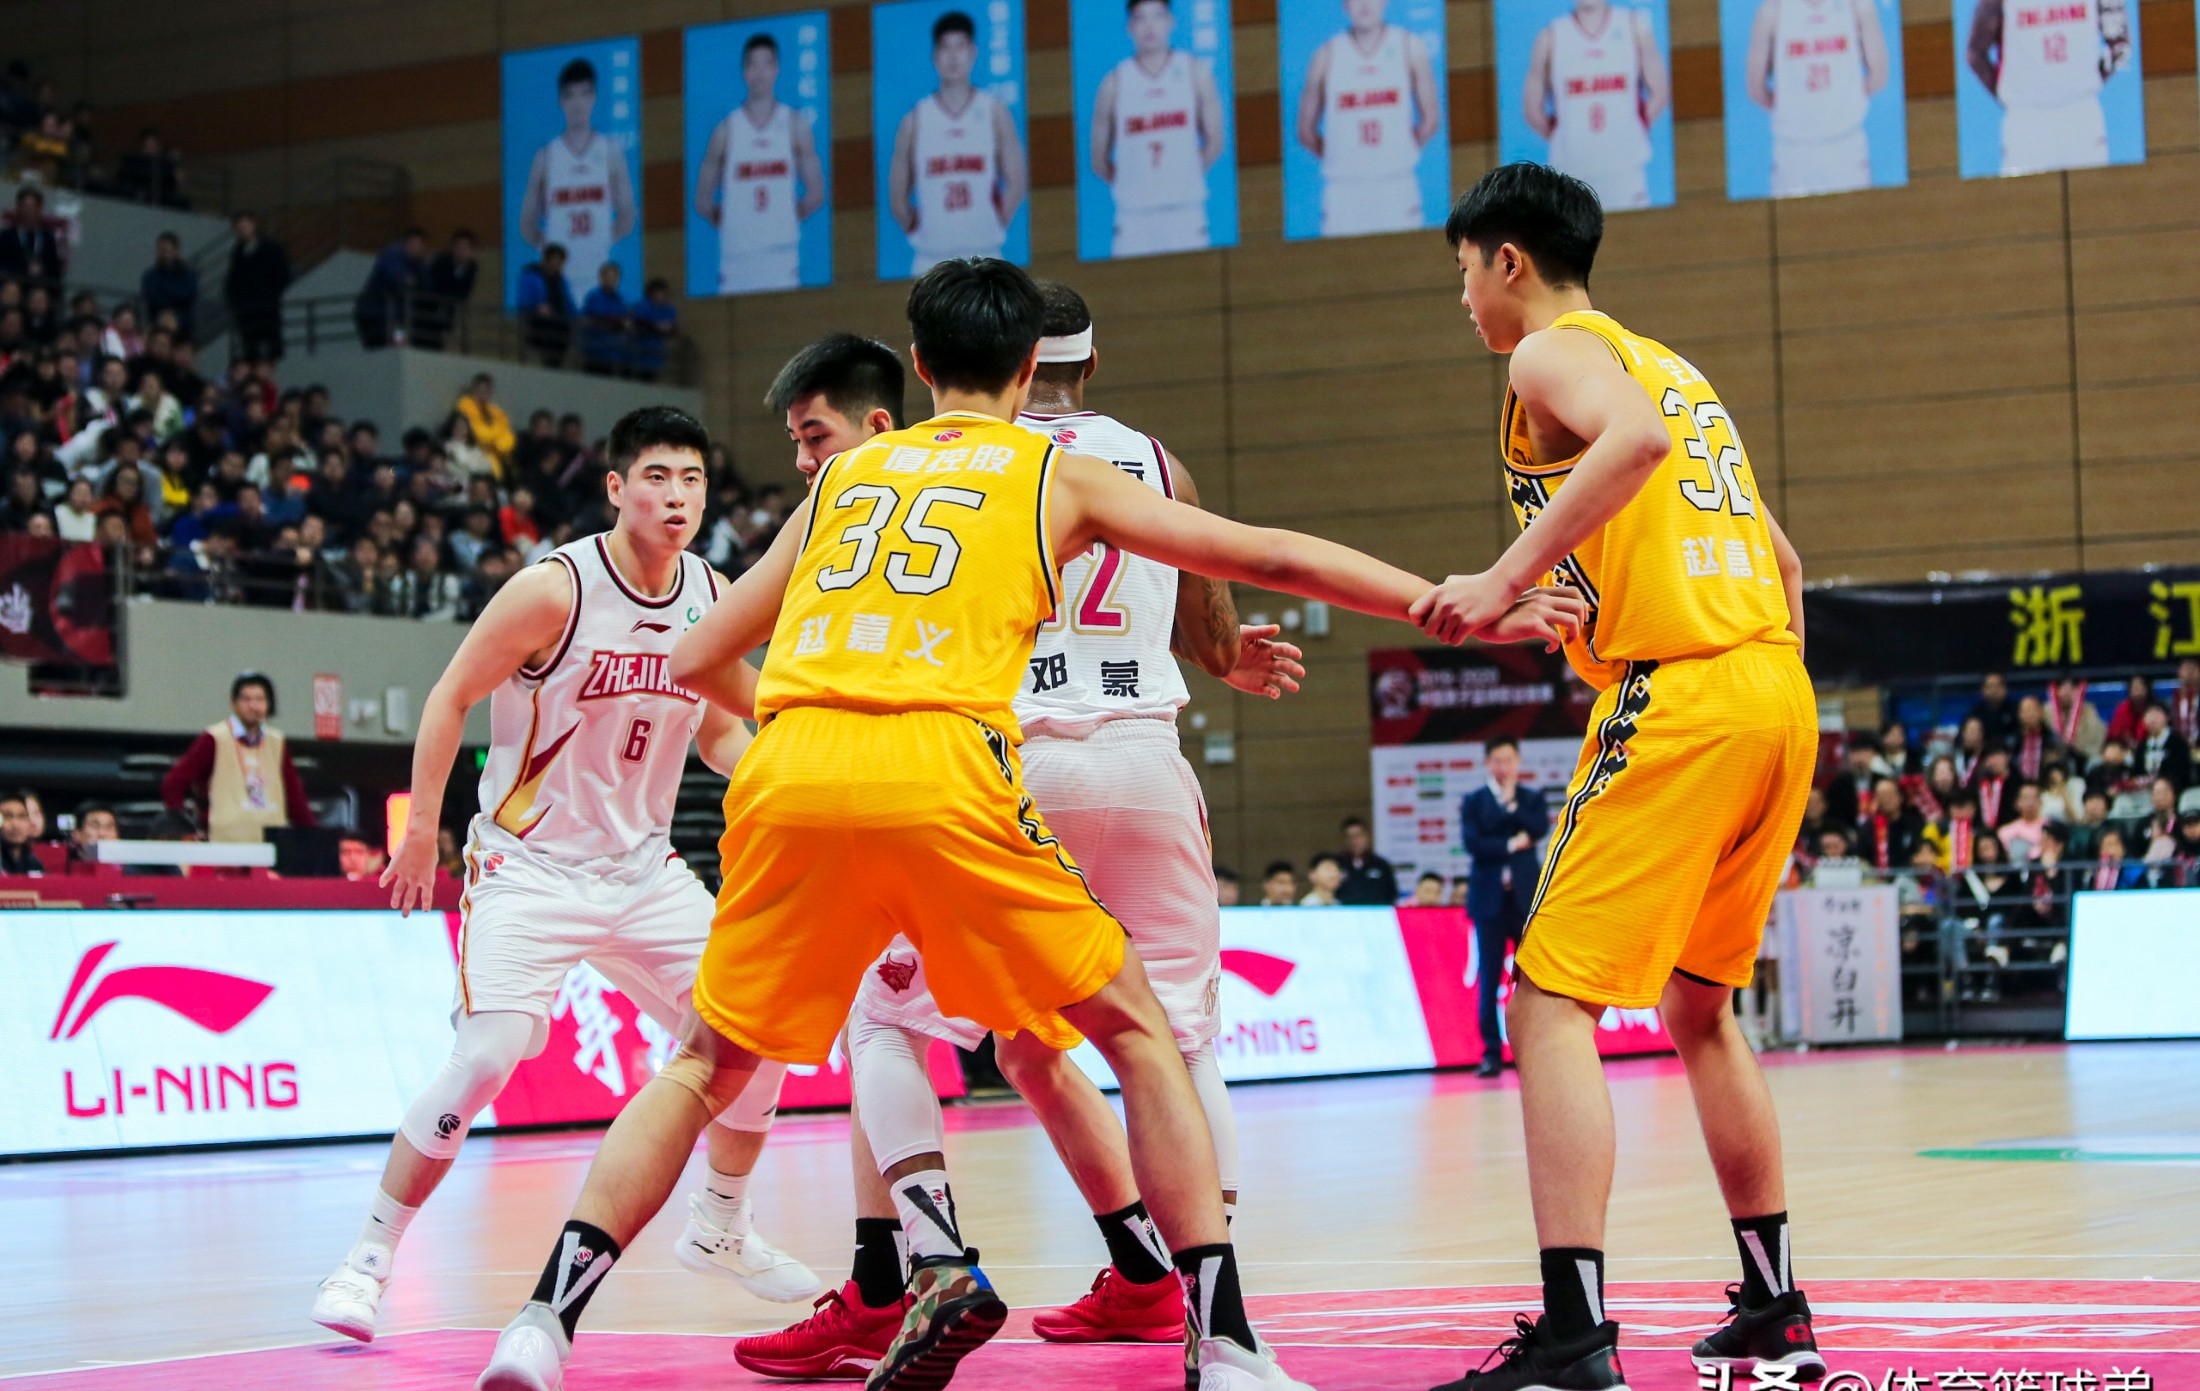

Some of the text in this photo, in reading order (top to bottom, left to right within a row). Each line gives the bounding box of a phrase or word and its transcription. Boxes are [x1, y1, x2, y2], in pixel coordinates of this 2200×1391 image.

[1149, 141, 1164, 168] 7
[1660, 387, 1756, 521] 32
[816, 483, 986, 596] 35
[1681, 535, 1773, 586] 赵嘉
[1042, 544, 1131, 637] 2
[793, 612, 954, 667] 赵嘉义
[2008, 579, 2200, 666] 浙江
[1029, 652, 1140, 698] 邓蒙
[622, 717, 654, 763] 6
[64, 1062, 299, 1118] LI-NING
